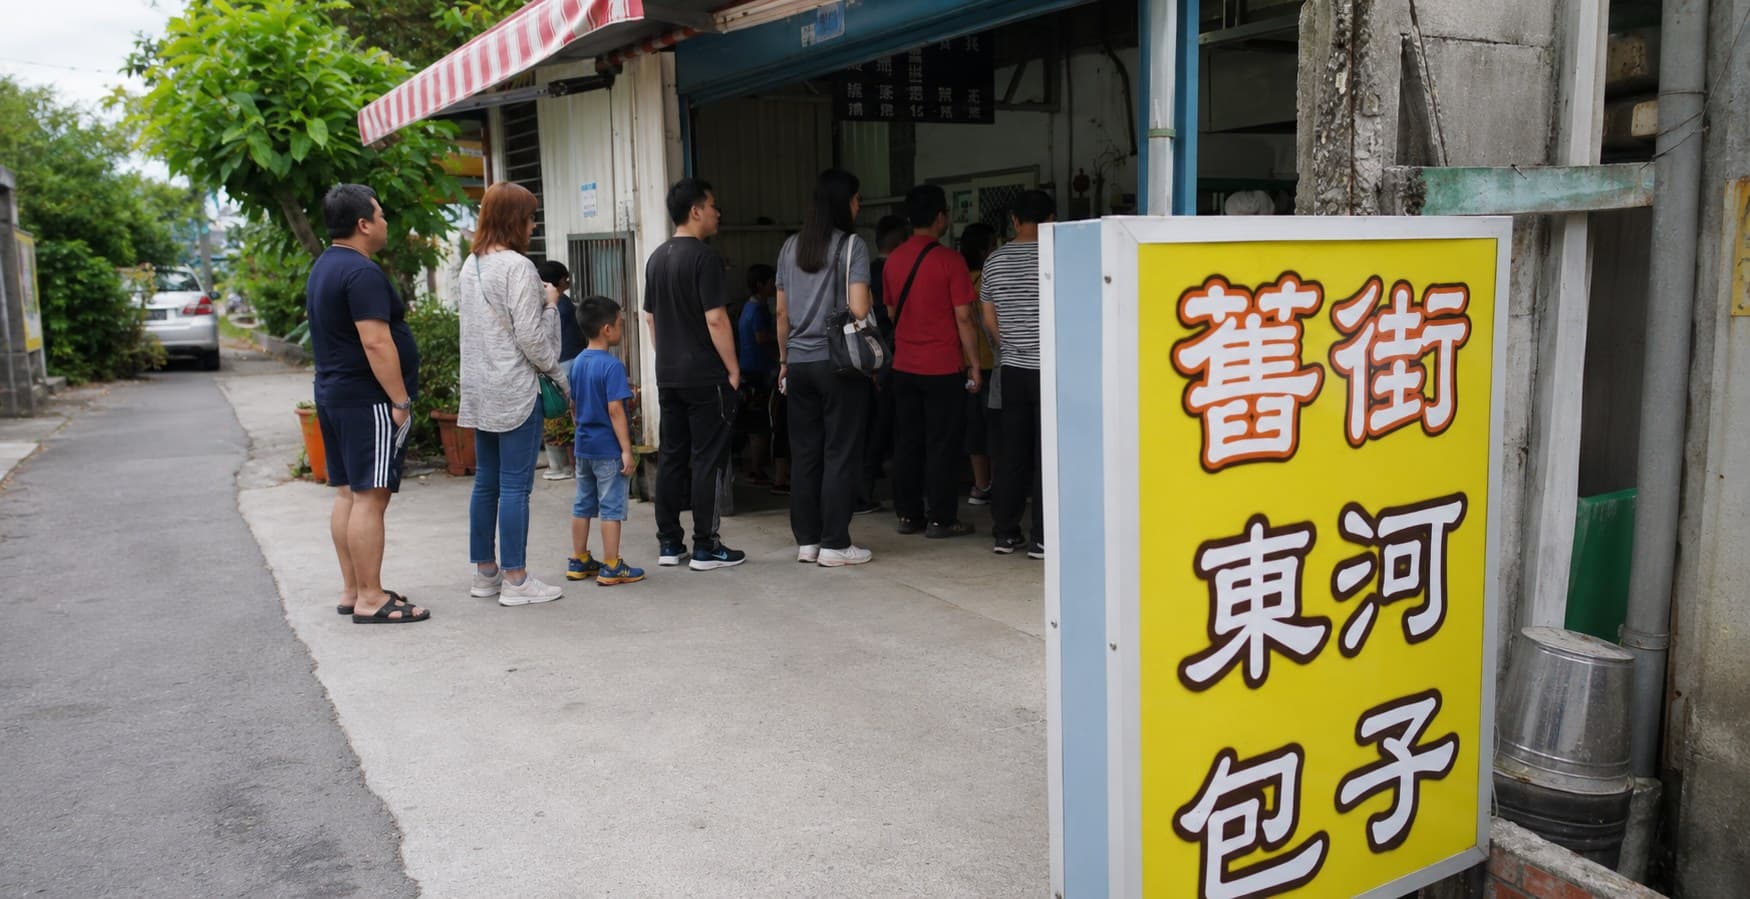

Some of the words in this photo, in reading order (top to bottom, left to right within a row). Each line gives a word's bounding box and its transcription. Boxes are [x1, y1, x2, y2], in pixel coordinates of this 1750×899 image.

[1174, 274, 1469, 469] 舊街
[1181, 495, 1464, 686] 東河
[1175, 692, 1457, 899] 包子
